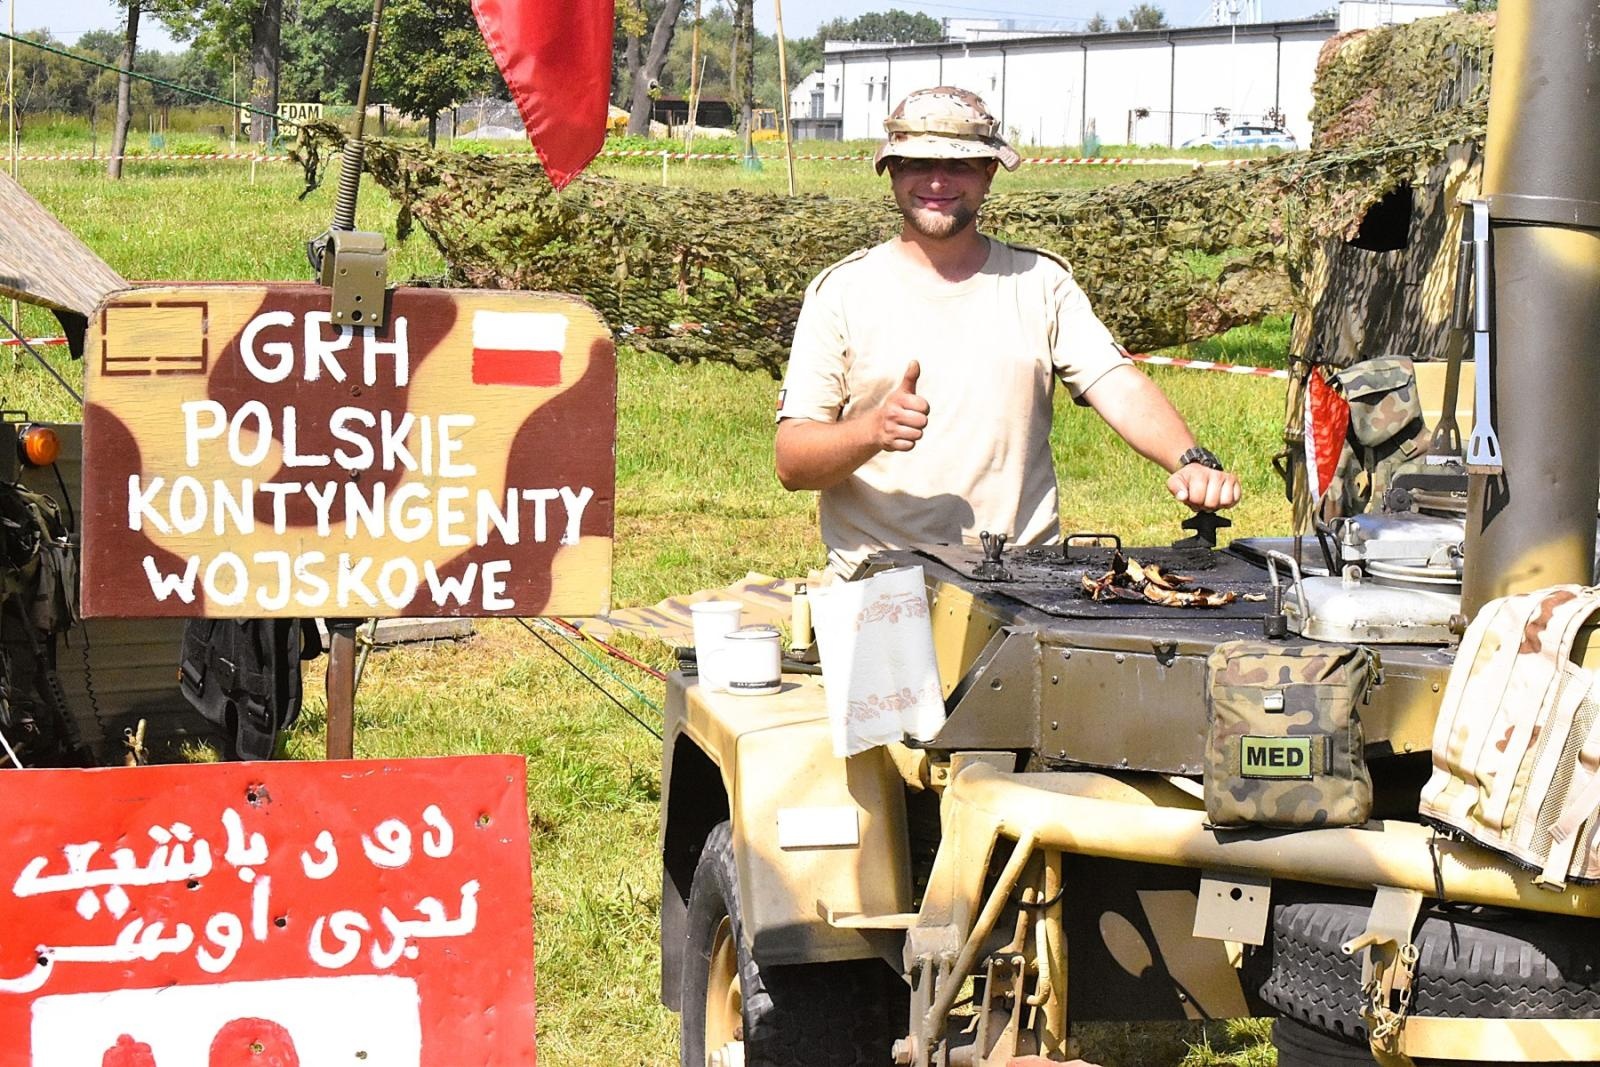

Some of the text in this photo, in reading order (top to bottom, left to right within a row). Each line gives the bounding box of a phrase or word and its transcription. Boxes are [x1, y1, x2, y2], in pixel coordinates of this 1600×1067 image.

[239, 310, 409, 387] GRH
[181, 400, 476, 478] POLSKIE
[128, 474, 594, 548] KONTYNGENTY
[142, 549, 516, 611] WOJSKOWE
[1247, 746, 1304, 767] MED
